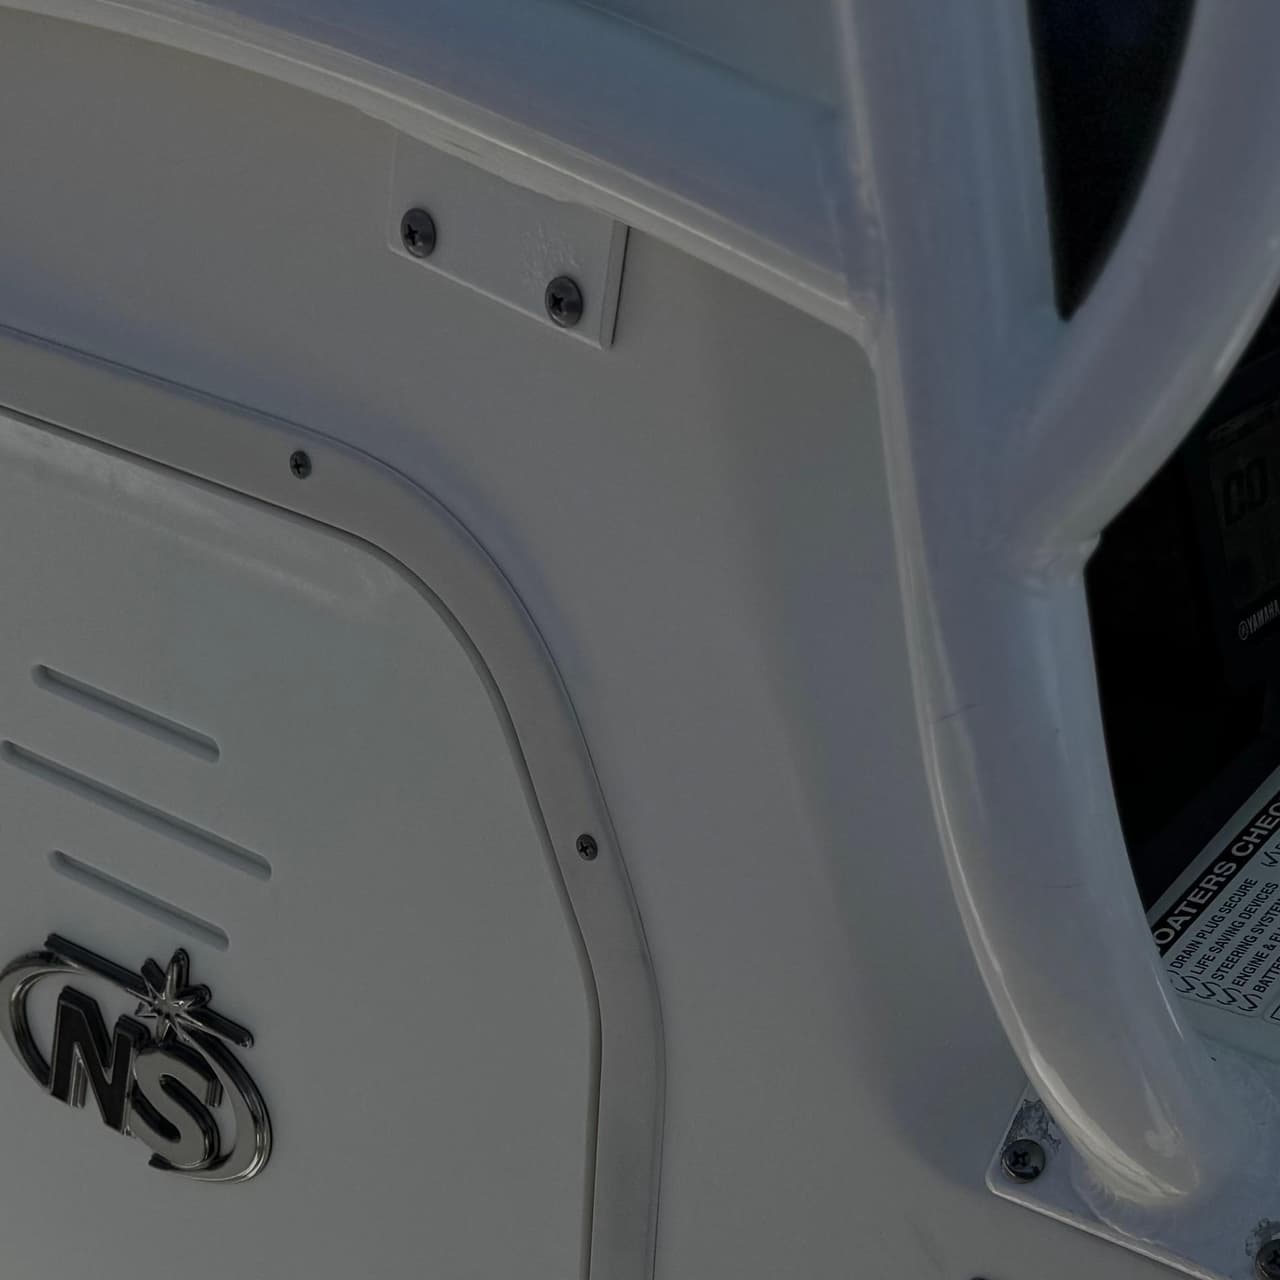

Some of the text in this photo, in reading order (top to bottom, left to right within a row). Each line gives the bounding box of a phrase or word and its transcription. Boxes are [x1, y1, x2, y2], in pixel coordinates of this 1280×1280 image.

[1247, 599, 1280, 636] YAMAHA
[1154, 861, 1236, 944] OATERS
[1169, 878, 1258, 969] DRAIN PLUG SECURE
[1190, 882, 1279, 975] LIFE SAVING DEVICES
[1211, 935, 1258, 981] STEERING
[1231, 951, 1270, 987] ENGINE
